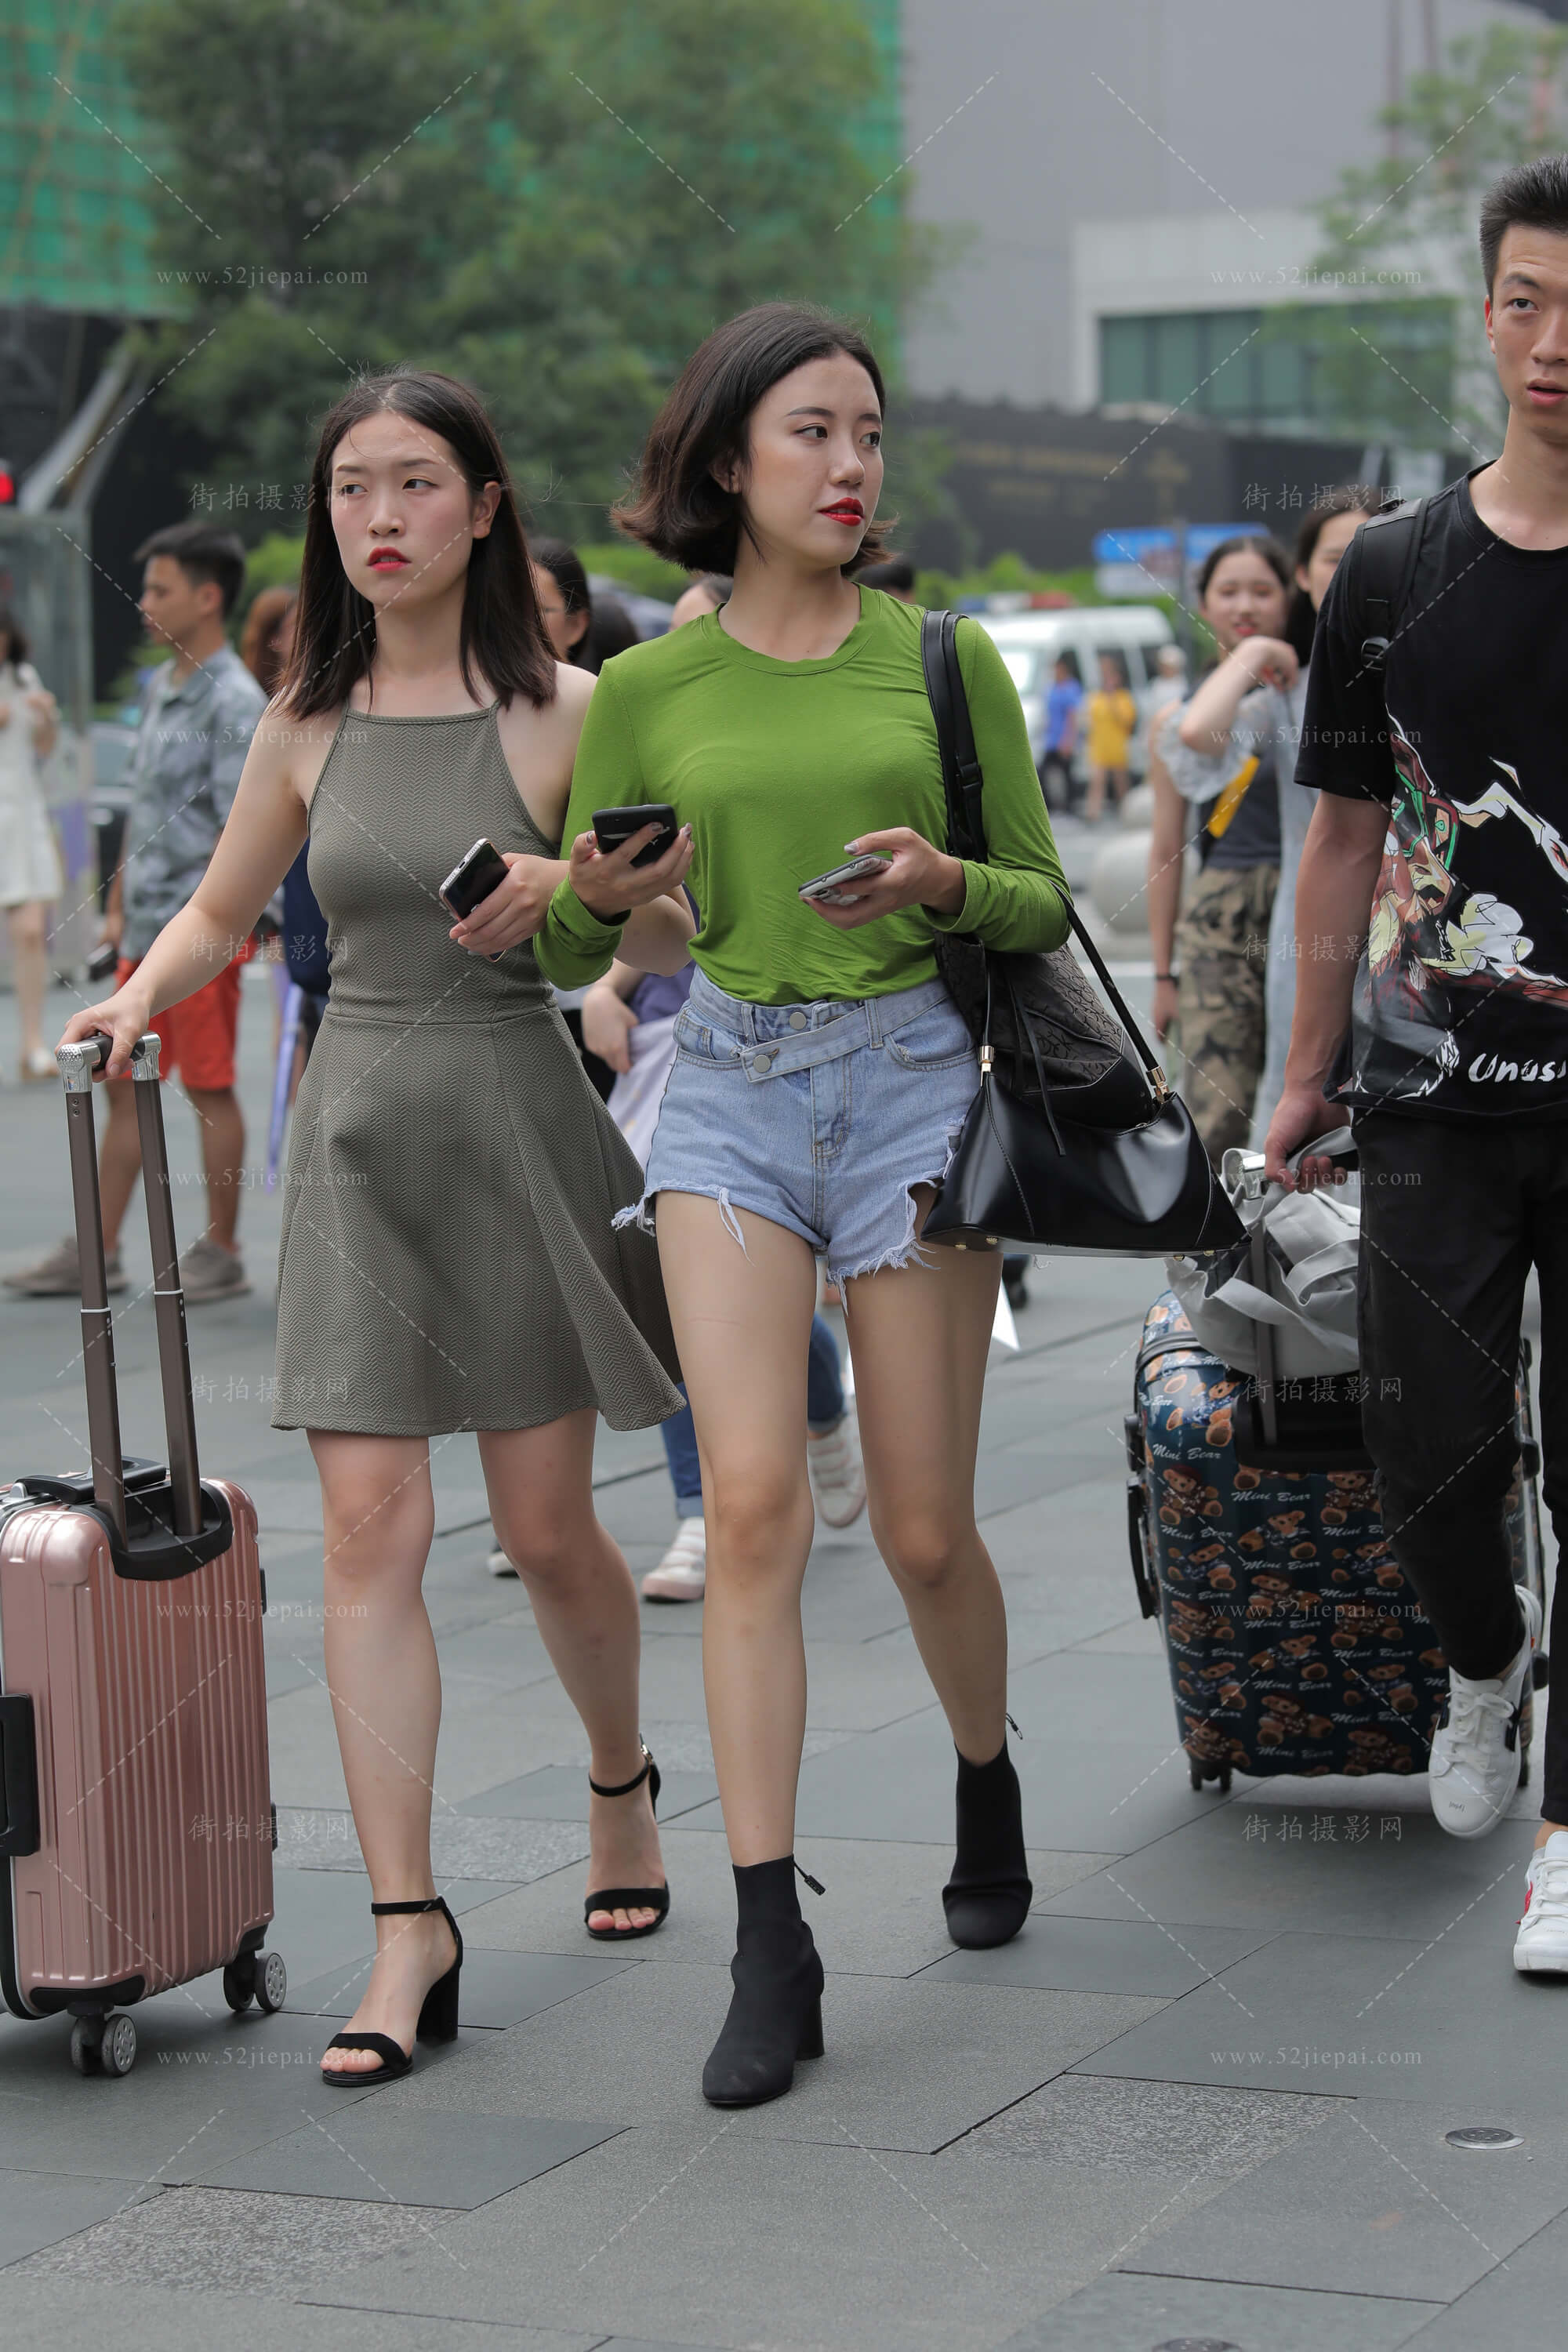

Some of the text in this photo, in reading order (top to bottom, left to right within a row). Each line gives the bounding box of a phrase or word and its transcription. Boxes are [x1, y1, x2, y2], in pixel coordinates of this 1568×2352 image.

[1152, 1443, 1221, 1461] Mini Bear
[1231, 1491, 1311, 1502] Mini Bear
[1160, 1525, 1195, 1540] Mini
[1323, 1526, 1362, 1537] Mini
[1287, 1561, 1321, 1570] Bear
[1319, 1588, 1358, 1599] Mini
